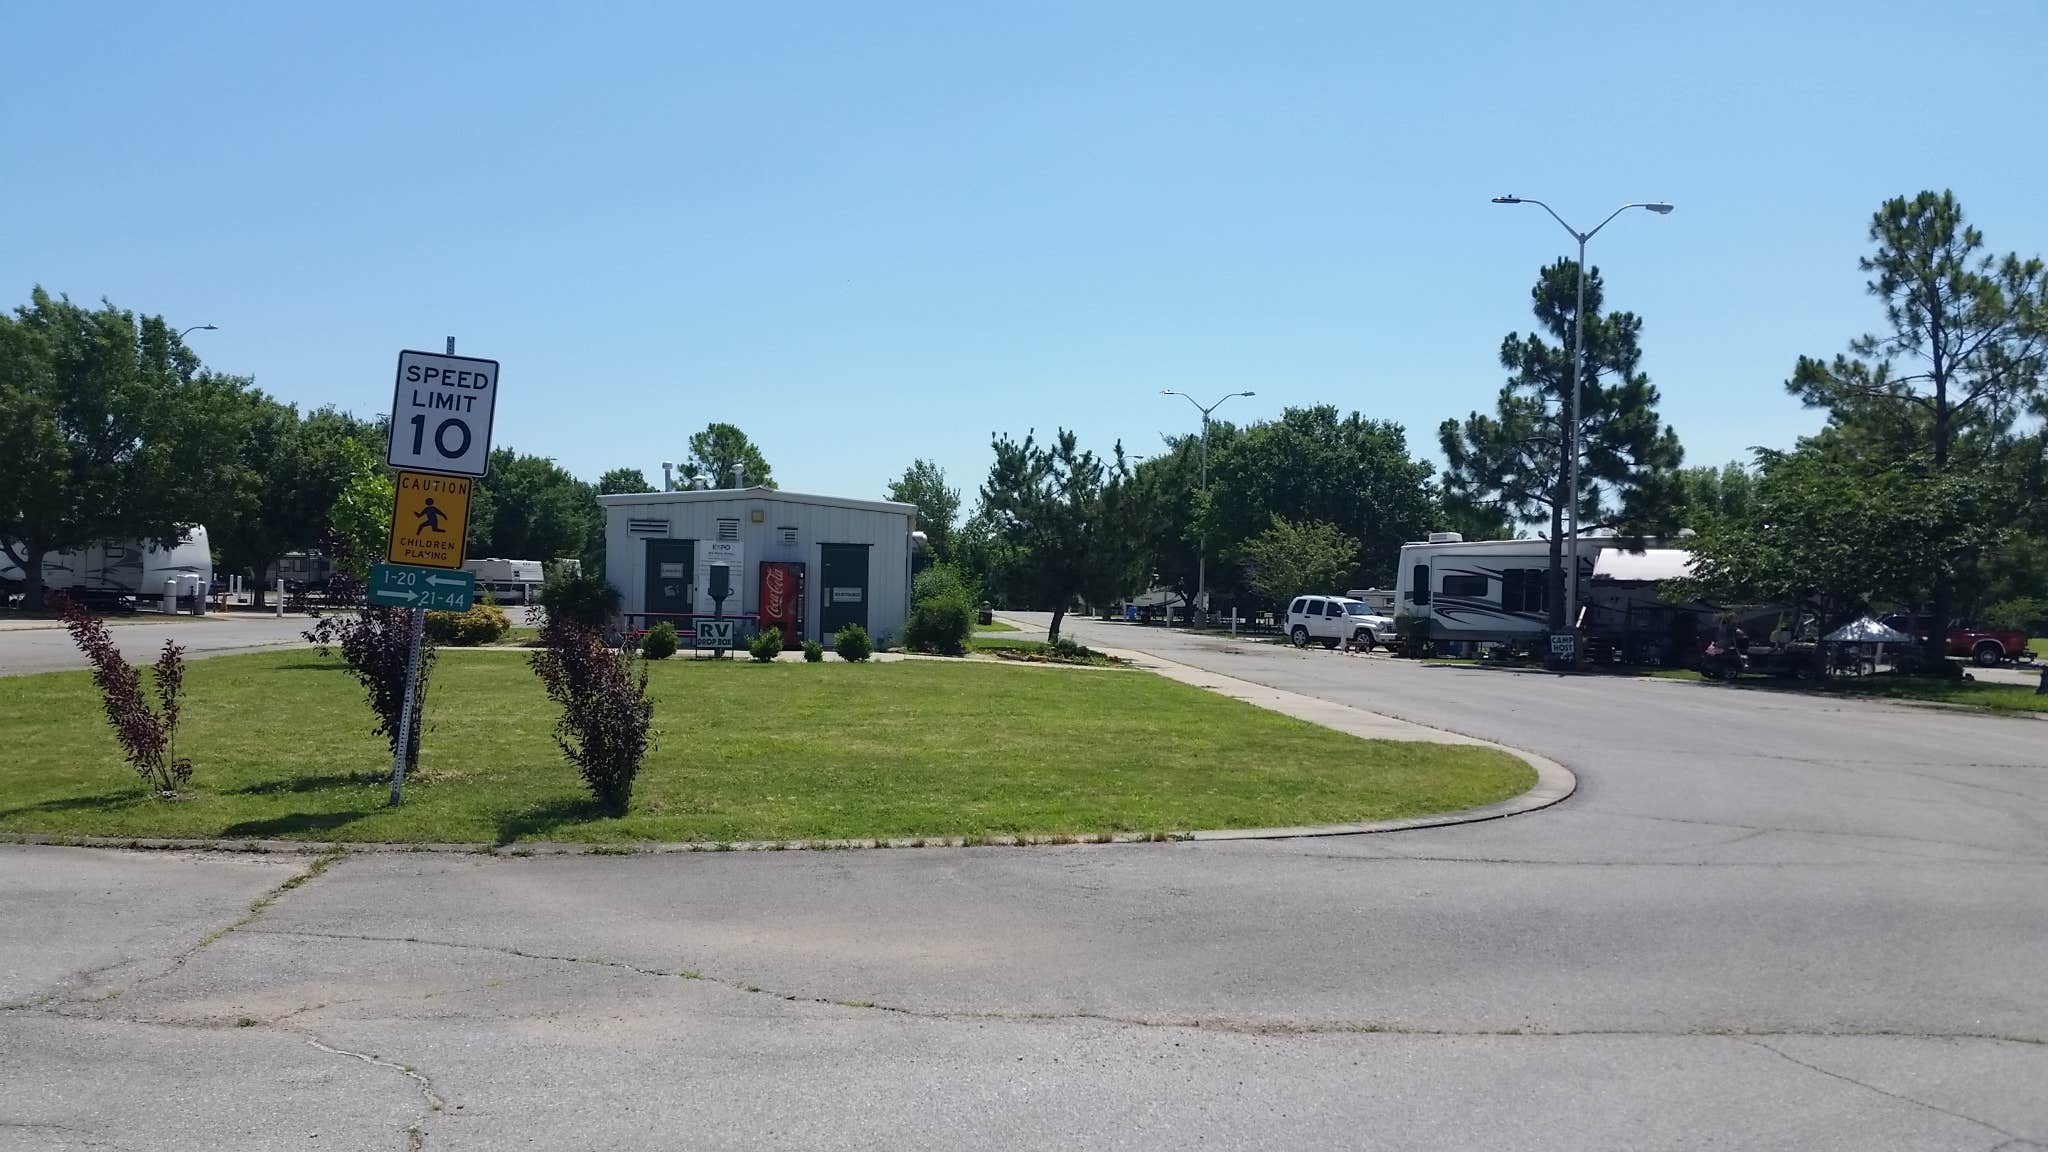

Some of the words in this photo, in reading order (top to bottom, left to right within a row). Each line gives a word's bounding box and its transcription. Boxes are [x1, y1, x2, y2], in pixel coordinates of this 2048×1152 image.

[406, 365, 489, 390] SPEED
[412, 389, 478, 413] LIMIT
[411, 414, 472, 459] 10
[402, 477, 467, 495] CAUTION
[400, 537, 455, 550] CHILDREN
[404, 549, 447, 560] PLAYING
[384, 570, 416, 586] 1-20
[420, 590, 464, 607] 21-44
[700, 623, 730, 638] RV
[697, 638, 717, 646] DROP
[717, 638, 732, 646] BOX
